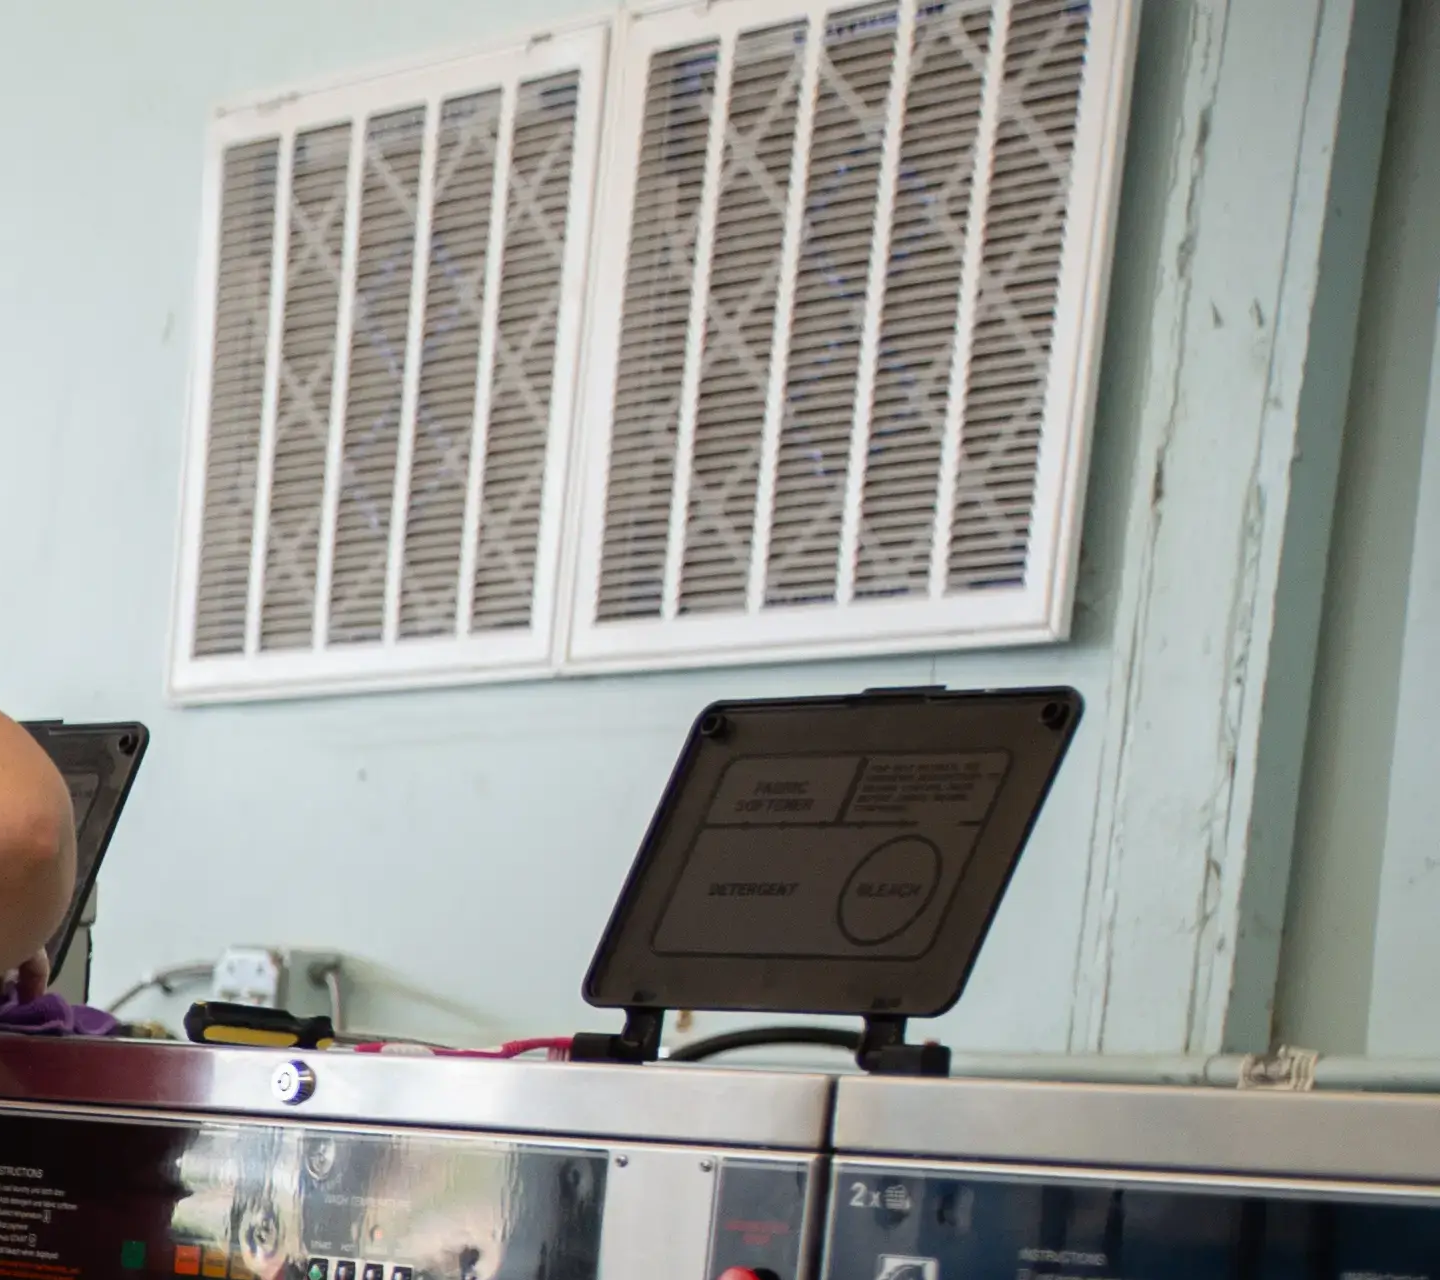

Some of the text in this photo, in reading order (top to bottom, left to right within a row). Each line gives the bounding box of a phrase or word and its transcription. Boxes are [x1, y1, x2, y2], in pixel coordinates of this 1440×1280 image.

[708, 882, 801, 898] DETERGENT
[856, 882, 924, 898] BLEACH
[849, 1182, 867, 1207] 2
